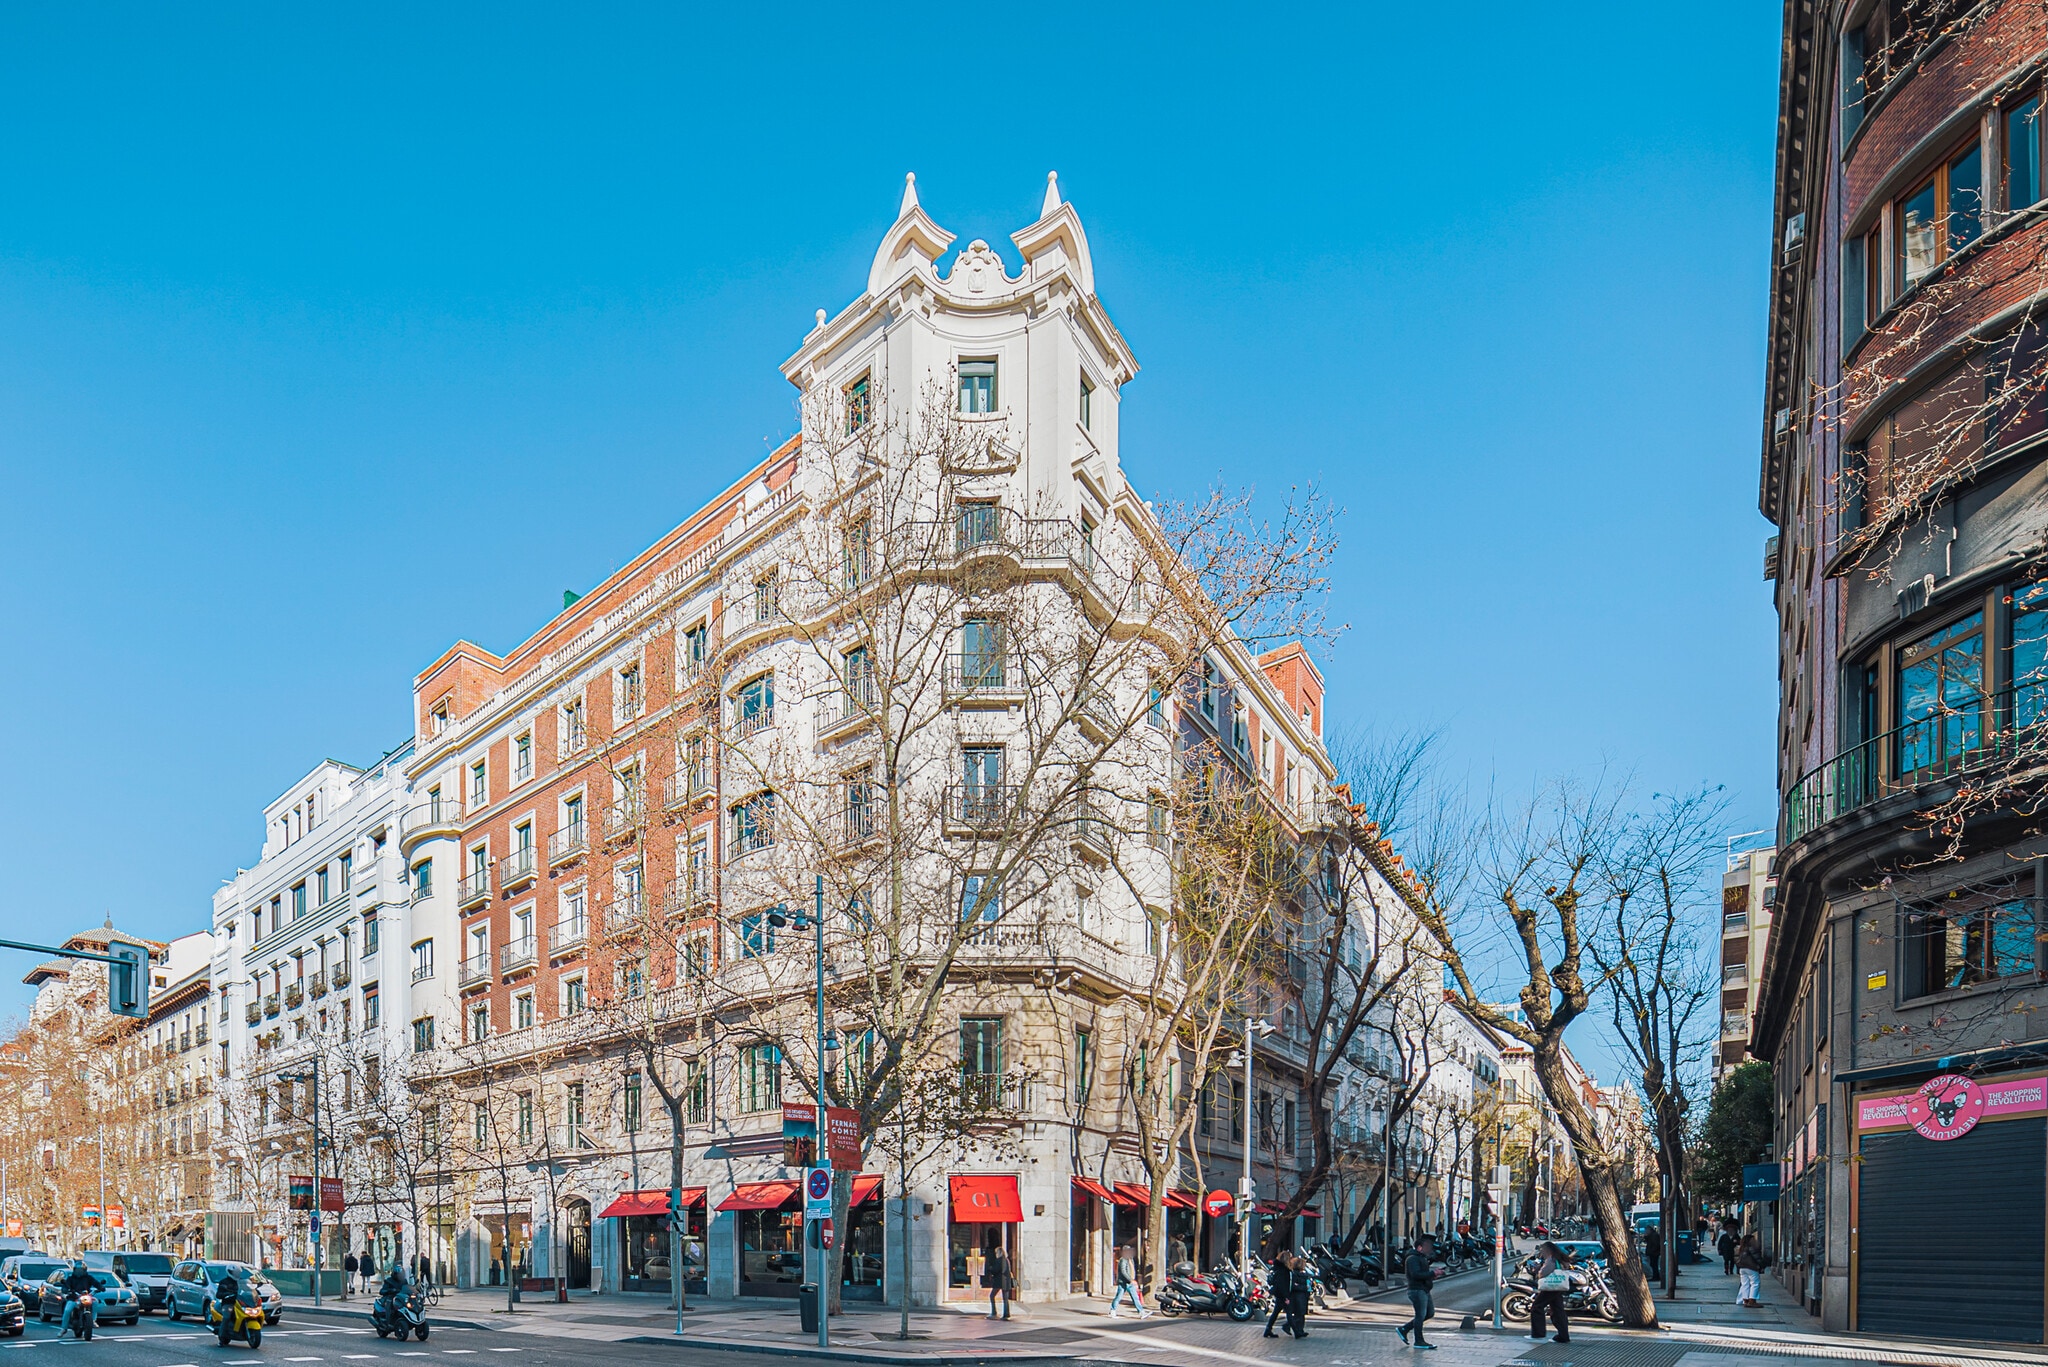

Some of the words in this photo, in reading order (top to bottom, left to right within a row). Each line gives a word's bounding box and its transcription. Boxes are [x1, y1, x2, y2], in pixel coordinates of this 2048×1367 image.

[1920, 1076, 1972, 1094] SHOPPING
[1987, 1093, 2042, 1106] REVOLUTION
[1988, 1091, 2002, 1099] THE
[2003, 1087, 2042, 1097] SHOPPING
[1862, 1109, 1907, 1120] REVOLUTION
[1863, 1107, 1875, 1115] THE
[1876, 1103, 1907, 1111] SHOPPING
[1915, 1116, 1977, 1139] REVOLUTION
[971, 1192, 1001, 1208] CH
